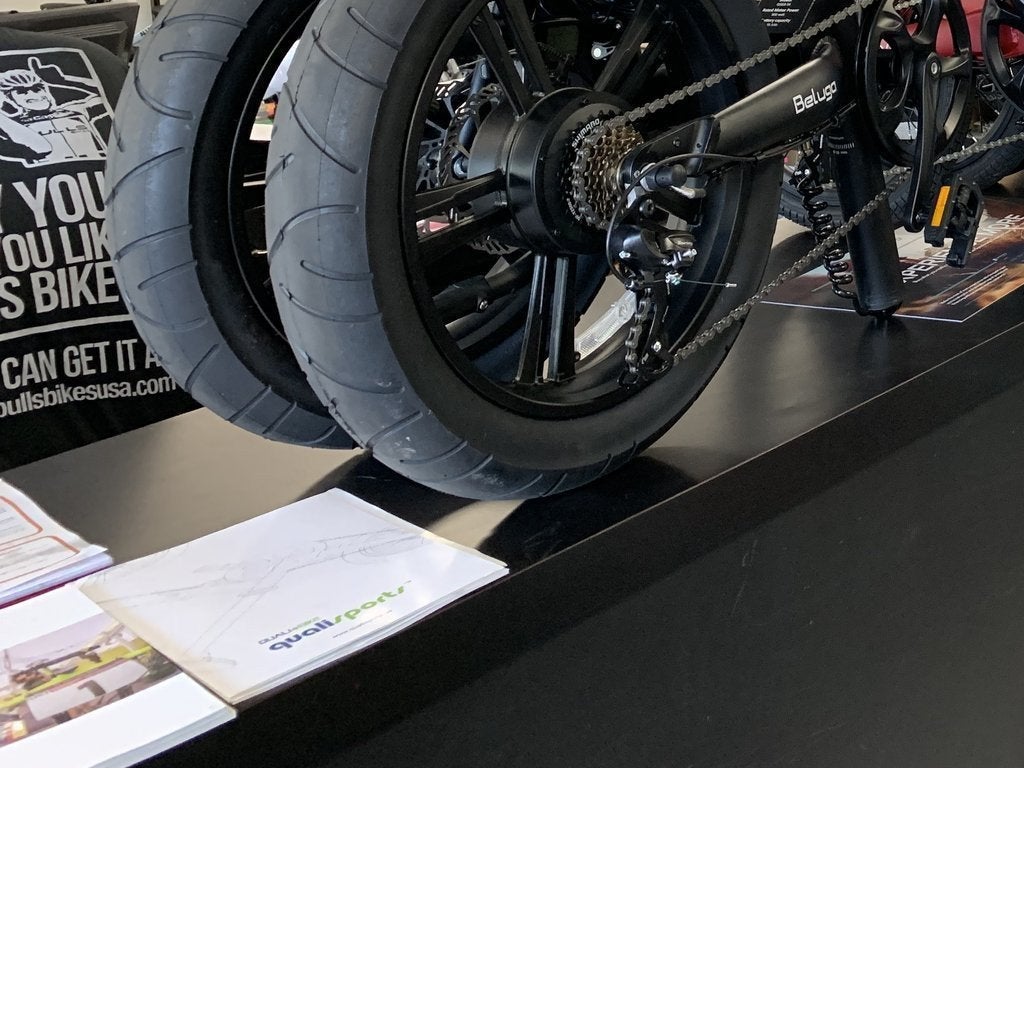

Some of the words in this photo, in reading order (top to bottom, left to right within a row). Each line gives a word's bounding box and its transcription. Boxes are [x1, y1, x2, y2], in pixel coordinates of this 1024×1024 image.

[571, 118, 600, 148] SHIMANO
[12, 171, 107, 228] YOU
[0, 228, 55, 273] OU
[58, 220, 111, 265] LIK
[30, 260, 120, 314] BIKE
[1, 348, 58, 390] CAN
[63, 341, 110, 378] GET
[115, 338, 139, 373] IT
[145, 345, 162, 370] A
[268, 585, 405, 652] qualisports
